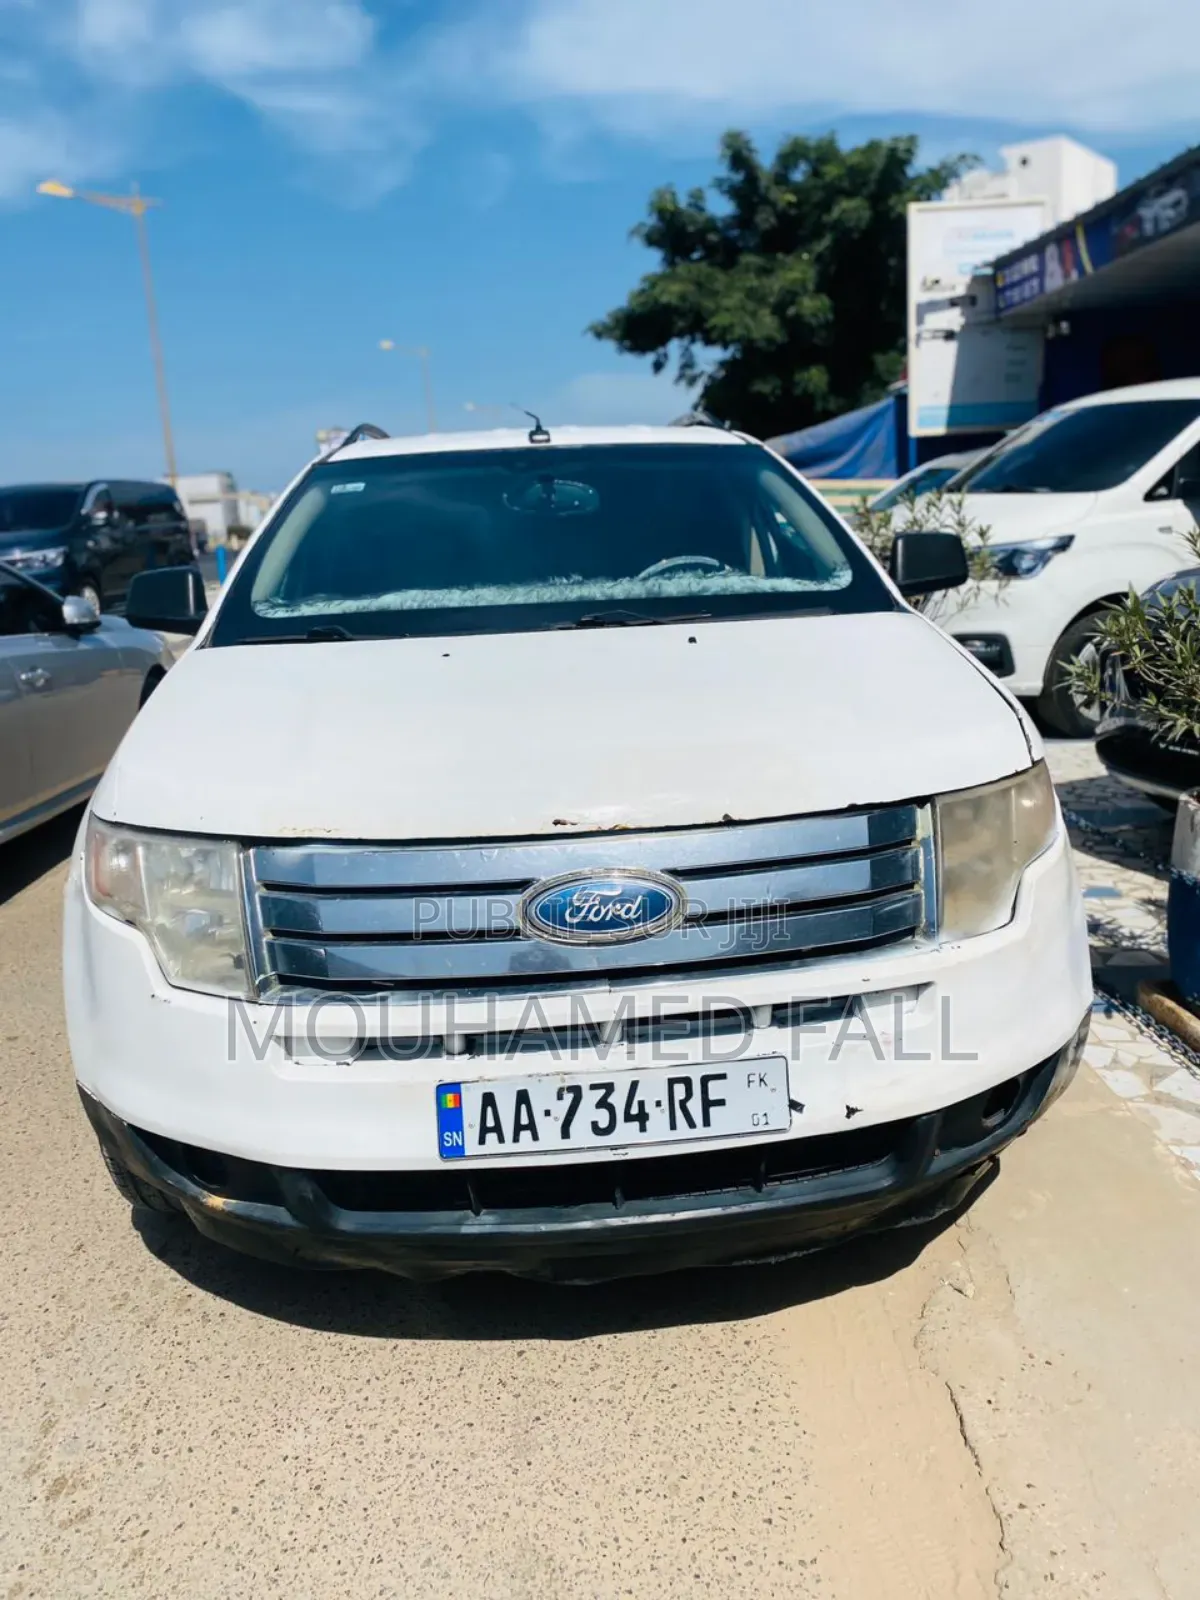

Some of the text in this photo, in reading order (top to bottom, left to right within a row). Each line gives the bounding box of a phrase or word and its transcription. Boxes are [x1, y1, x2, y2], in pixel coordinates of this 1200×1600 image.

[565, 886, 642, 924] Ford
[747, 1072, 769, 1089] FK
[443, 1131, 463, 1148] SN
